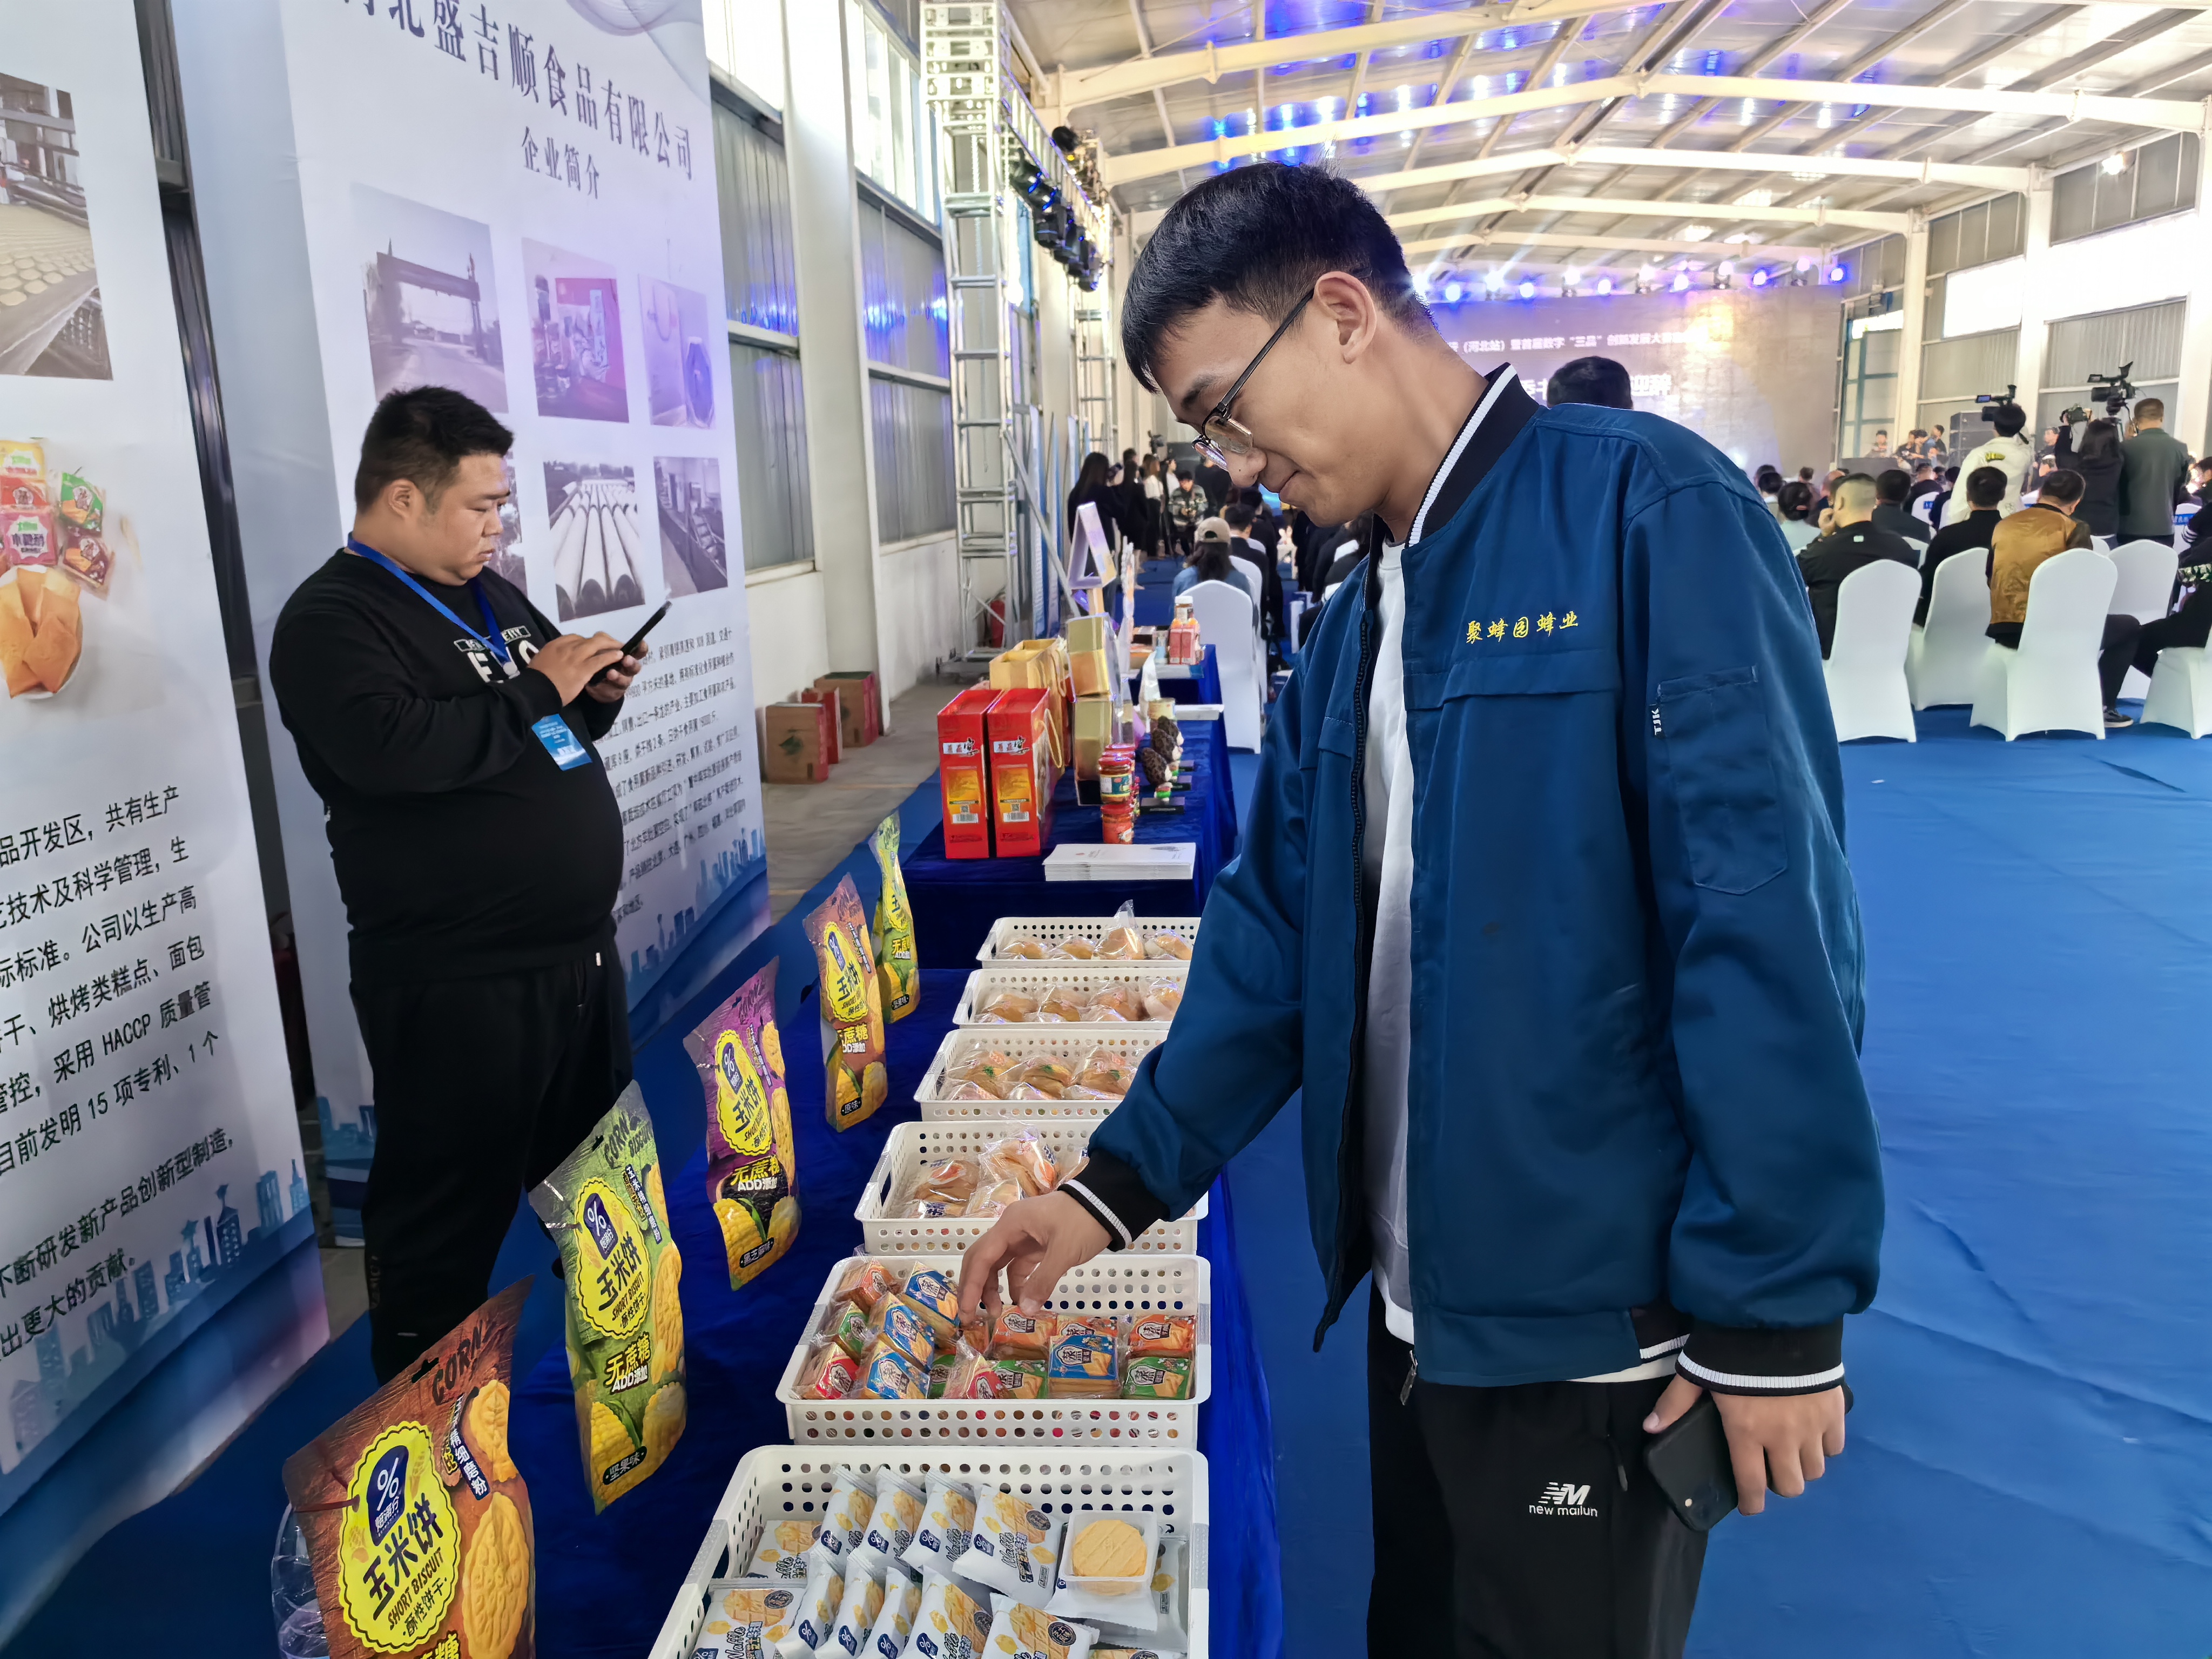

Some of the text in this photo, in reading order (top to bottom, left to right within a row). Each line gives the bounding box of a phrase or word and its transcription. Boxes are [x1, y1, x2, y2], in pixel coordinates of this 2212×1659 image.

[345, 0, 693, 180] 北盛吉顺食品有限公司
[522, 126, 599, 199] 企业简介
[1651, 707, 1662, 736] TJK
[0, 935, 205, 1056] 干、烘烤类糕点、面包
[102, 1014, 151, 1056] HACCP
[160, 981, 212, 1029] 质量管
[88, 1091, 108, 1120] 15
[203, 1030, 219, 1057] 个
[733, 1075, 761, 1134] 玉米饼
[596, 1231, 642, 1311] 玉米饼
[611, 1271, 645, 1321] SHORT BISCUIT
[432, 1319, 483, 1405] CORN
[605, 1333, 651, 1386] 无蔗糖
[1529, 1505, 1598, 1518] new mailun
[362, 1492, 444, 1621] 玉米饼
[999, 1532, 1017, 1569] Waffle
[388, 1546, 444, 1631] SHORT BISCUIT
